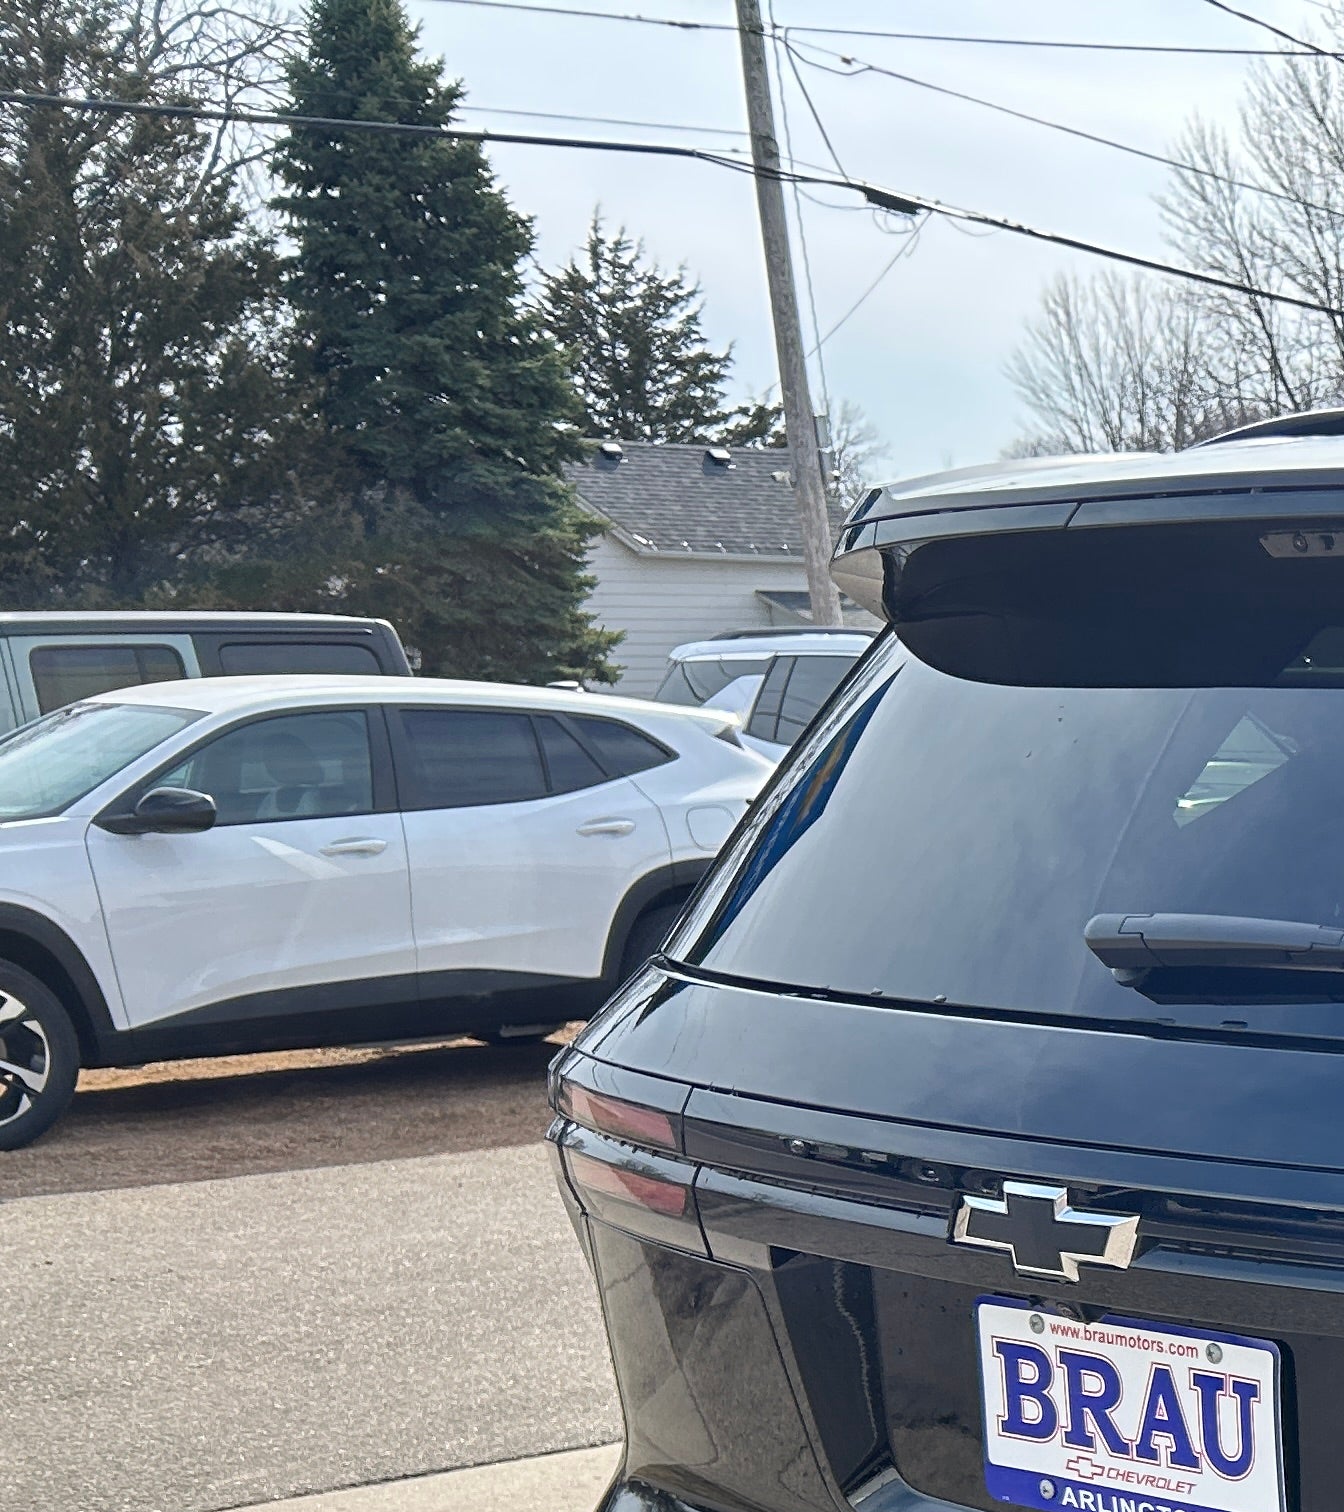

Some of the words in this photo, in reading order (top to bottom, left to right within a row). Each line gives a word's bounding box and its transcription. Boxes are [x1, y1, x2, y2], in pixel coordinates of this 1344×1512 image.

[1050, 1321, 1199, 1359] www.braumotors.com
[991, 1335, 1261, 1482] BRAU
[1106, 1467, 1198, 1495] CHEVROLET
